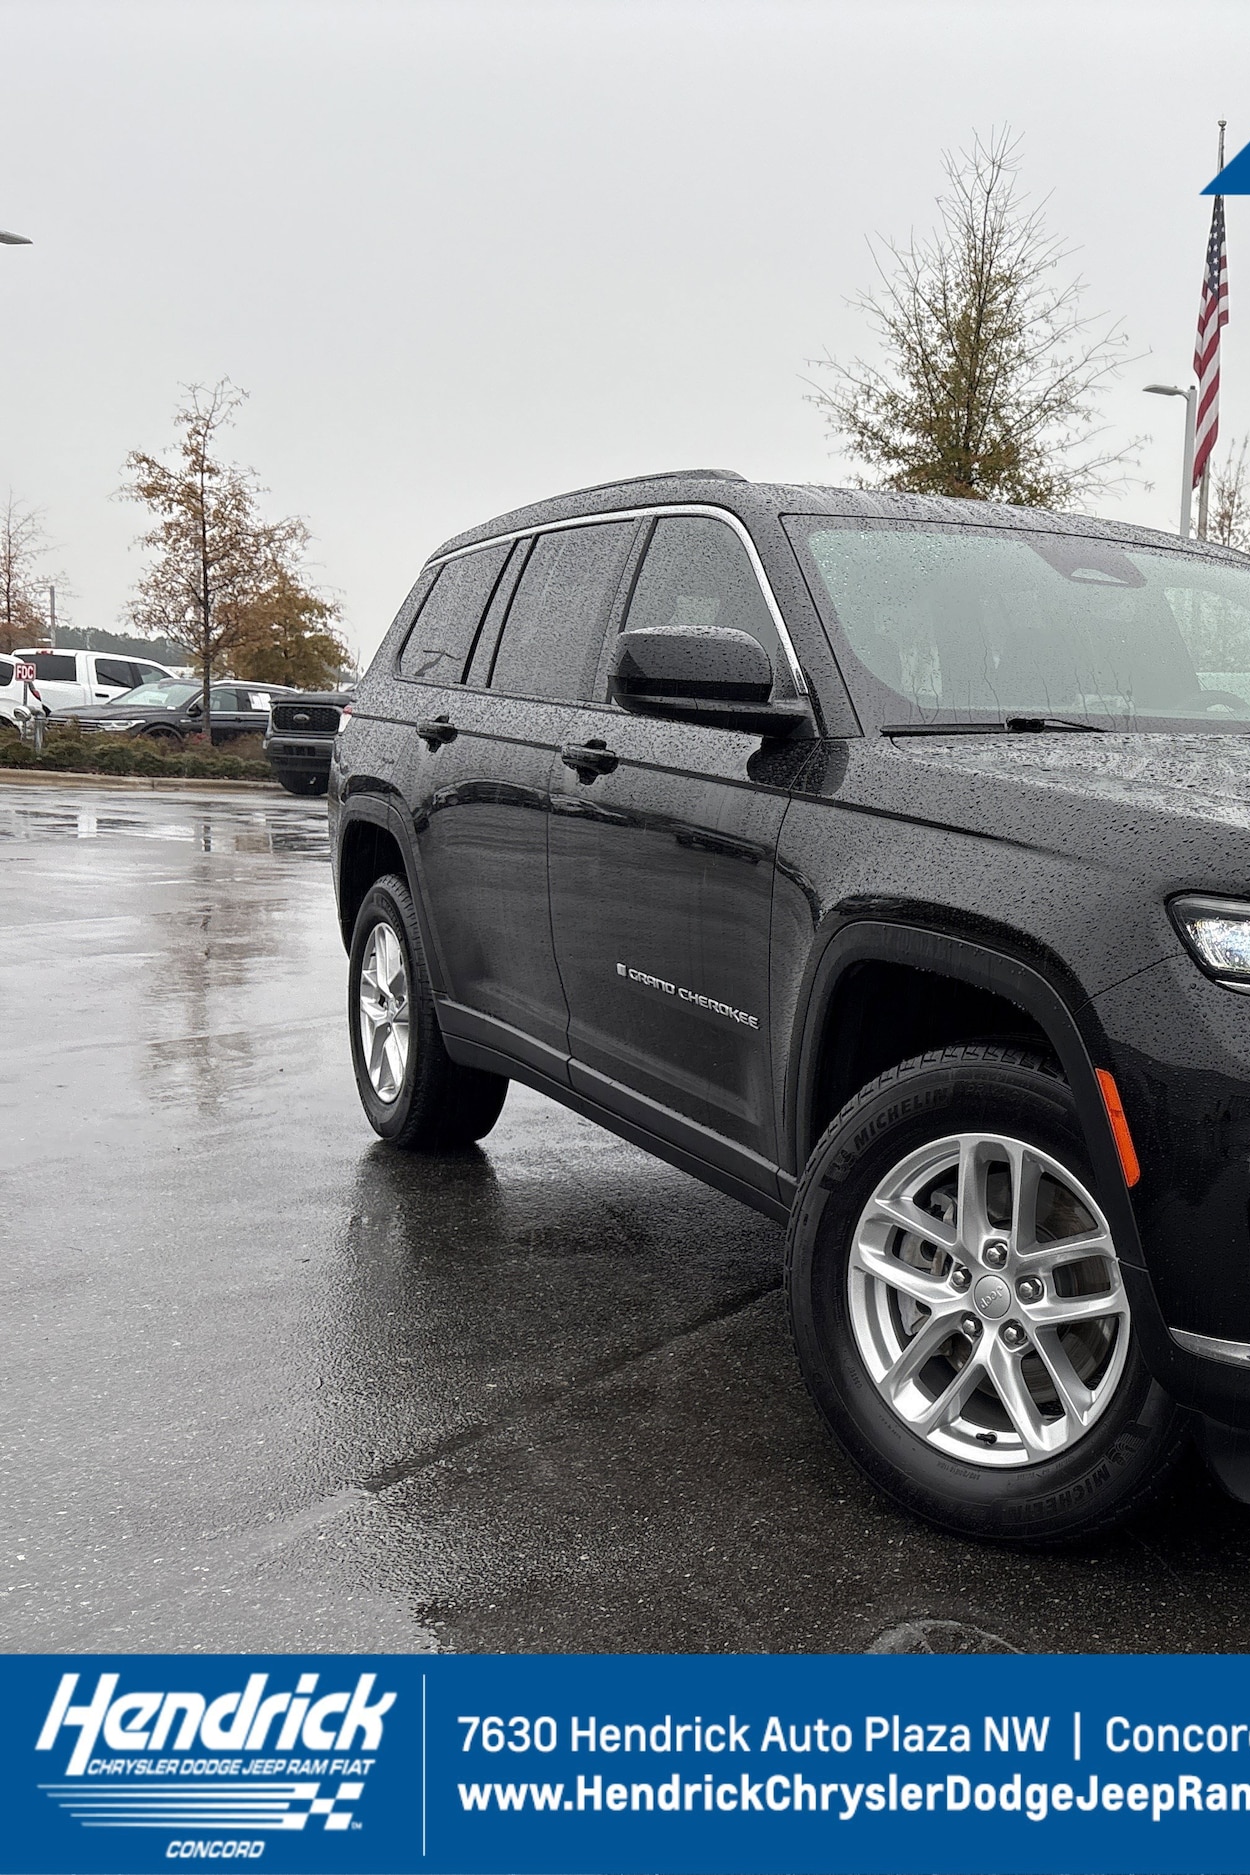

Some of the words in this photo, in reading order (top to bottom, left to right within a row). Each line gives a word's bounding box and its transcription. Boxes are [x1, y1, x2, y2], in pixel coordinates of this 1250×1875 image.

[16, 664, 35, 680] FDC
[628, 968, 676, 996] GRAND
[677, 987, 760, 1030] CHEROKEE
[853, 1087, 950, 1150] MICHELIN
[980, 1285, 1004, 1310] Jeep
